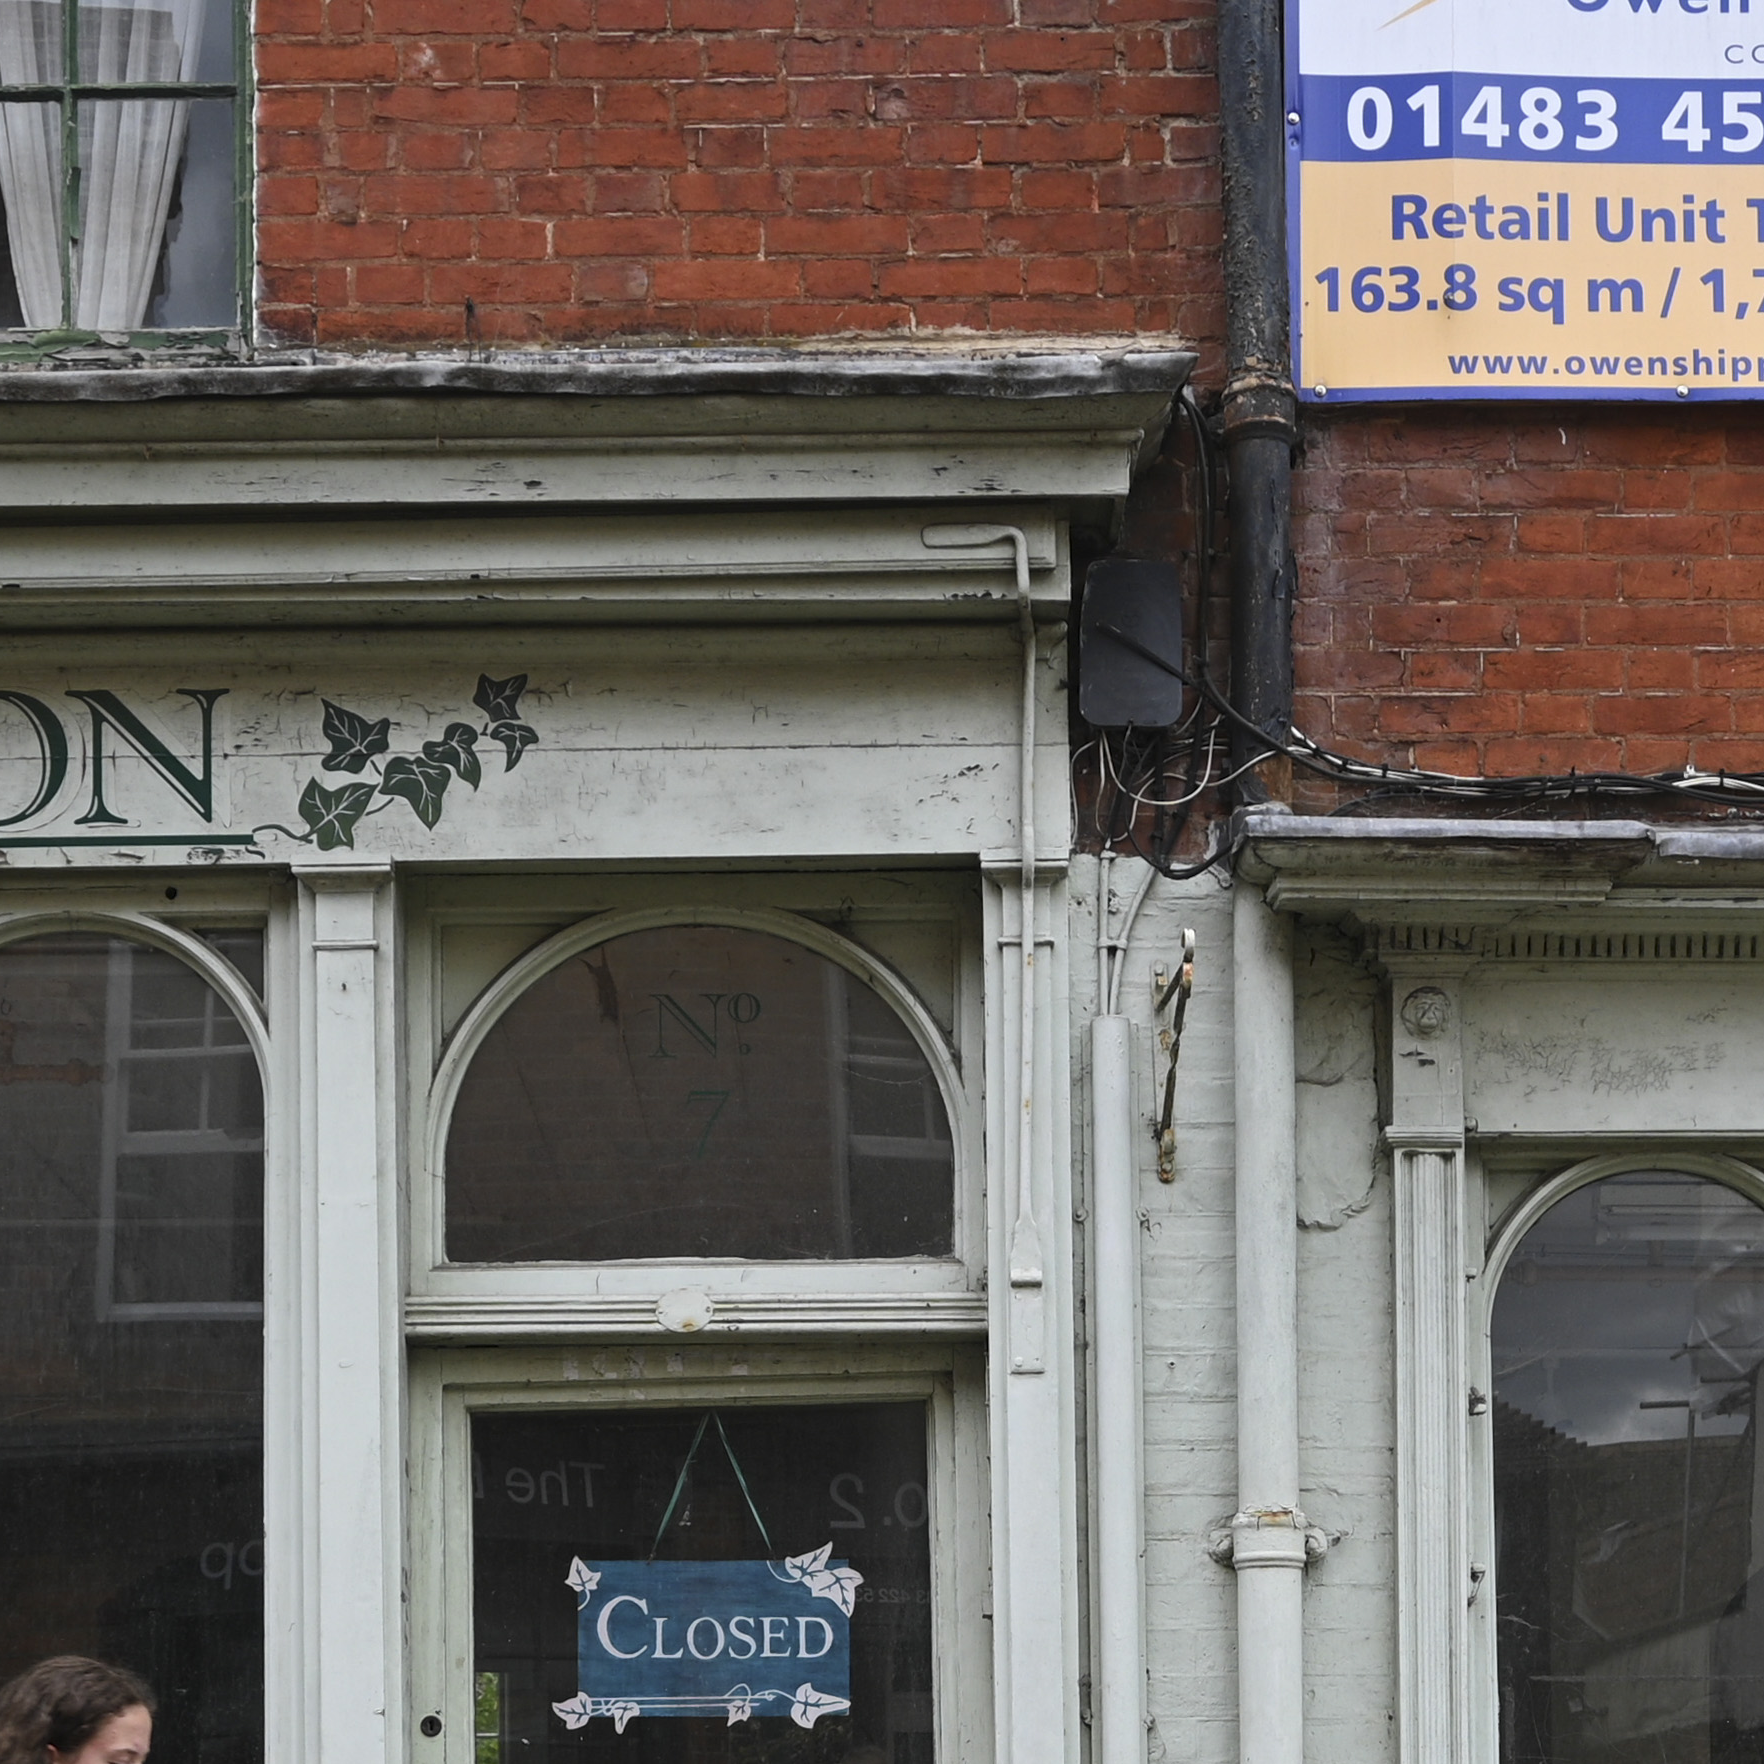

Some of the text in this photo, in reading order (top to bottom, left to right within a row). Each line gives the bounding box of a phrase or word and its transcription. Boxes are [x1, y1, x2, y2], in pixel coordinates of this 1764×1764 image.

[1346, 84, 1620, 152] 01483
[1391, 192, 1571, 242] Retail
[1595, 194, 1726, 244] Unit
[1314, 264, 1478, 314] 163.8
[1497, 277, 1566, 325] sq
[1586, 277, 1645, 314] m
[1659, 266, 1681, 317] /
[686, 1089, 732, 1160] 7
[596, 1595, 836, 1661] CLOSED
